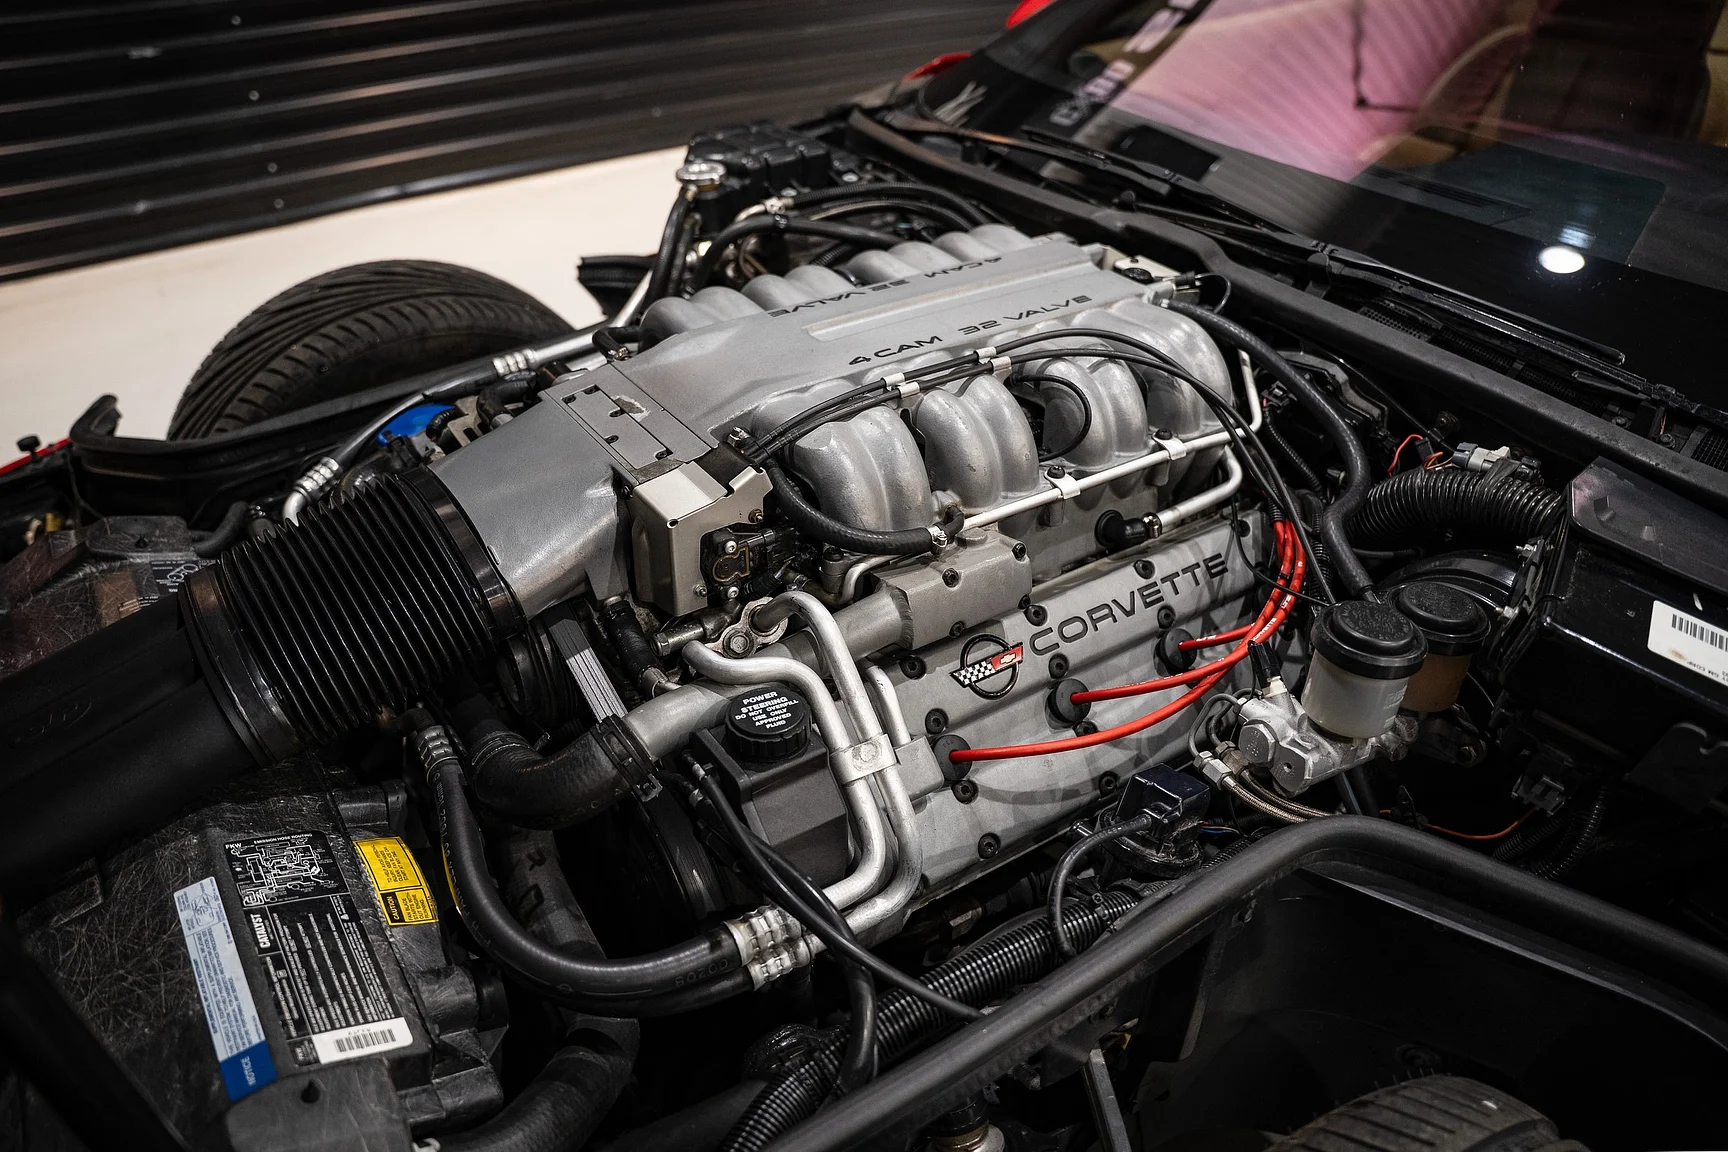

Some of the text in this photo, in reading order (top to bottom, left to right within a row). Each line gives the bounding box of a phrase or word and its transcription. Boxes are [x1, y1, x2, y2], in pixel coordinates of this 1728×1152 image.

[768, 291, 866, 318] VALVE
[957, 320, 1002, 336] 32
[1003, 295, 1093, 322] VALVE
[1029, 553, 1229, 656] CORVETTE
[741, 696, 788, 713] STEERING
[743, 691, 778, 705] POWER
[748, 709, 763, 717] NOT
[766, 699, 799, 712] OVERFILL
[752, 707, 787, 721] USE ONLY
[755, 712, 792, 727] APPROVED
[765, 719, 786, 729] FLUID
[386, 896, 400, 919] CAUTION
[401, 897, 410, 911] BLADE
[411, 894, 420, 908] ENGINE
[409, 903, 418, 919] STARTS
[251, 913, 270, 948] CATALYST
[240, 1054, 257, 1086] NOTICE
